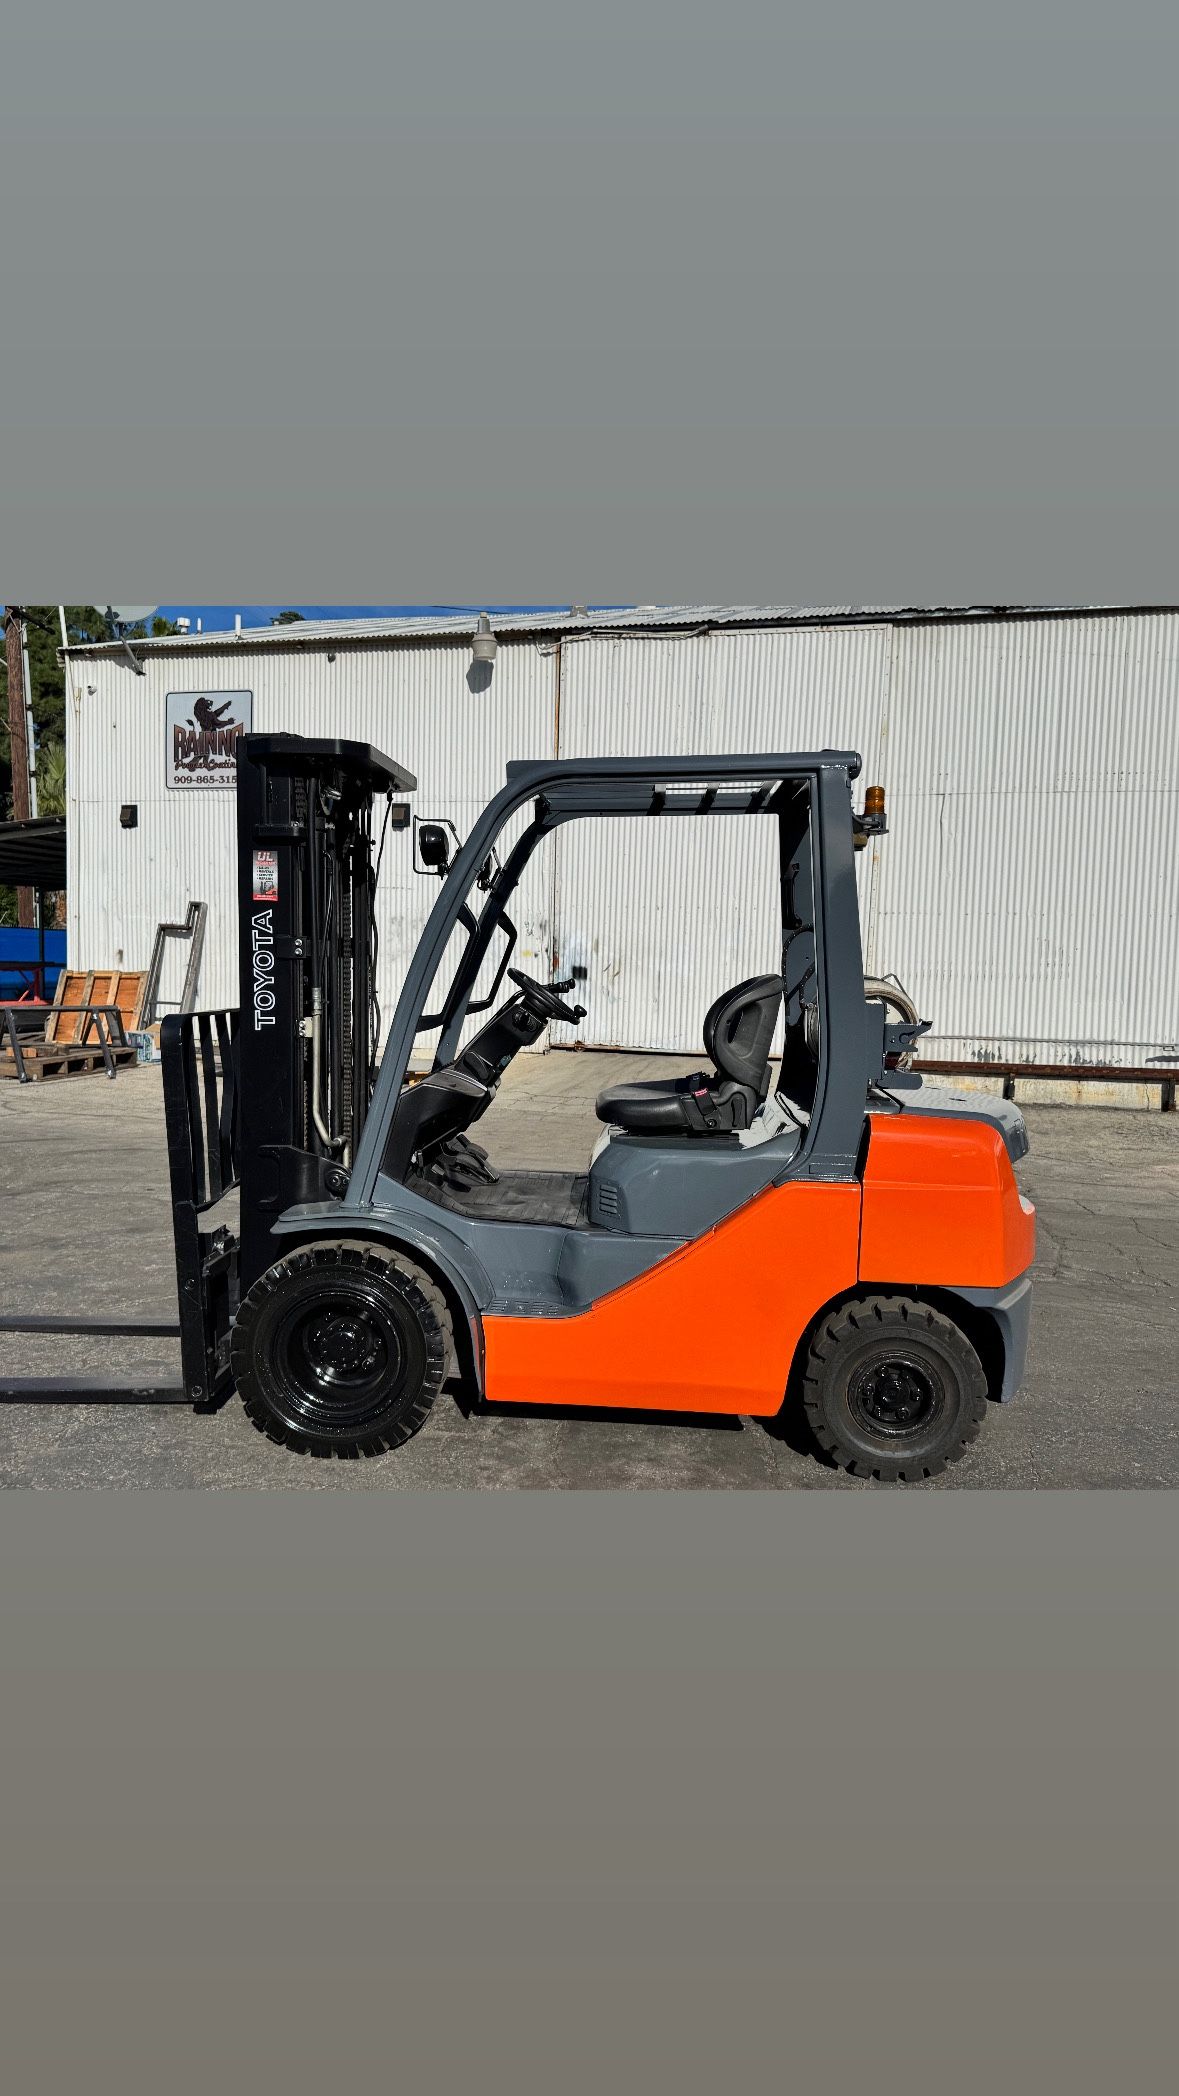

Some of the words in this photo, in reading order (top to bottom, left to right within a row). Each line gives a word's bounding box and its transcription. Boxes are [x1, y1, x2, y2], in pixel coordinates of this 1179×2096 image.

[206, 759, 237, 772] Coatin
[174, 776, 237, 784] 909-865-315
[252, 909, 275, 1030] TOYOTA
